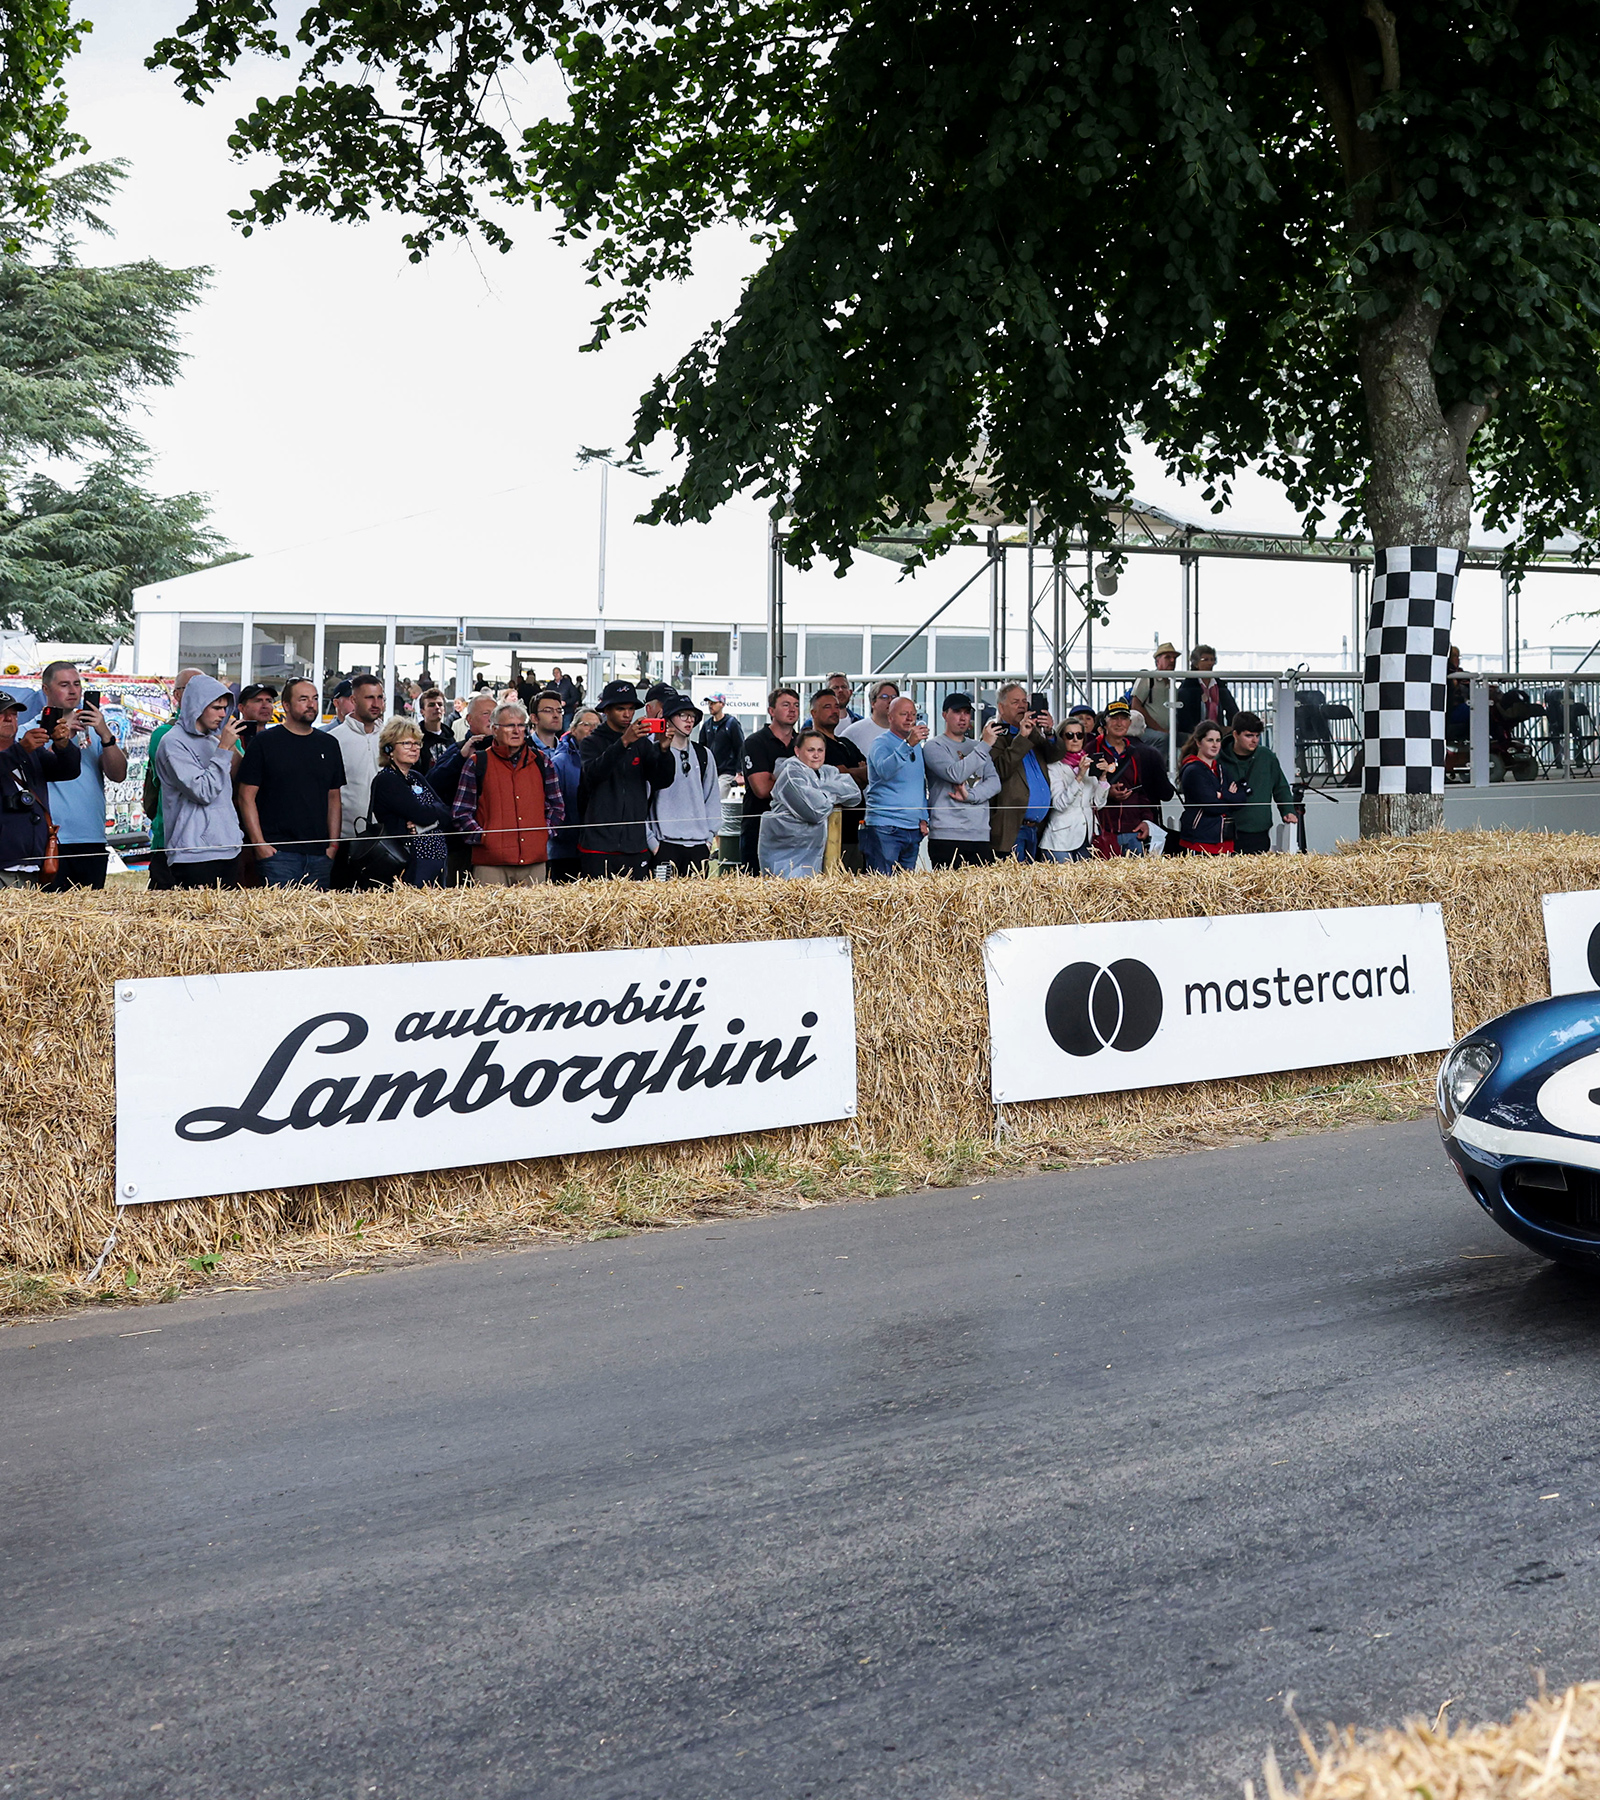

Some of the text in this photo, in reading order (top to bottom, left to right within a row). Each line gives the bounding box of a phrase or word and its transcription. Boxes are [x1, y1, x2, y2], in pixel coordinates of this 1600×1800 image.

[395, 977, 707, 1043] automobili
[1185, 954, 1410, 1016] mastercard
[175, 1012, 819, 1141] Lamborghini
